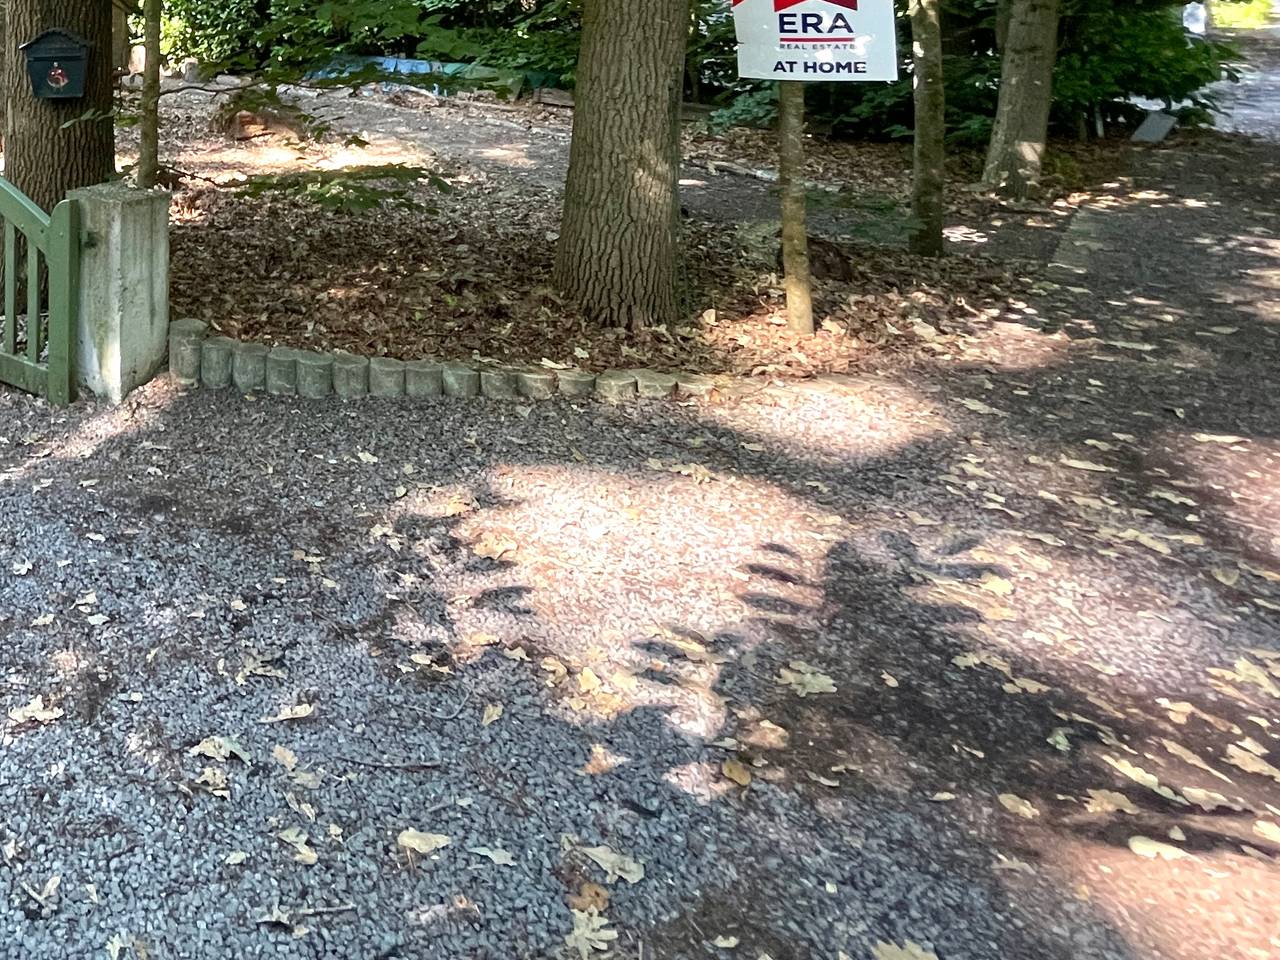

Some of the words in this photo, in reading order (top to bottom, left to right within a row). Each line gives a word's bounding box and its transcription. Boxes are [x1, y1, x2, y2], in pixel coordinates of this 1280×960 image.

[778, 12, 854, 34] ERA
[773, 60, 798, 73] AT
[803, 61, 867, 73] HOME
